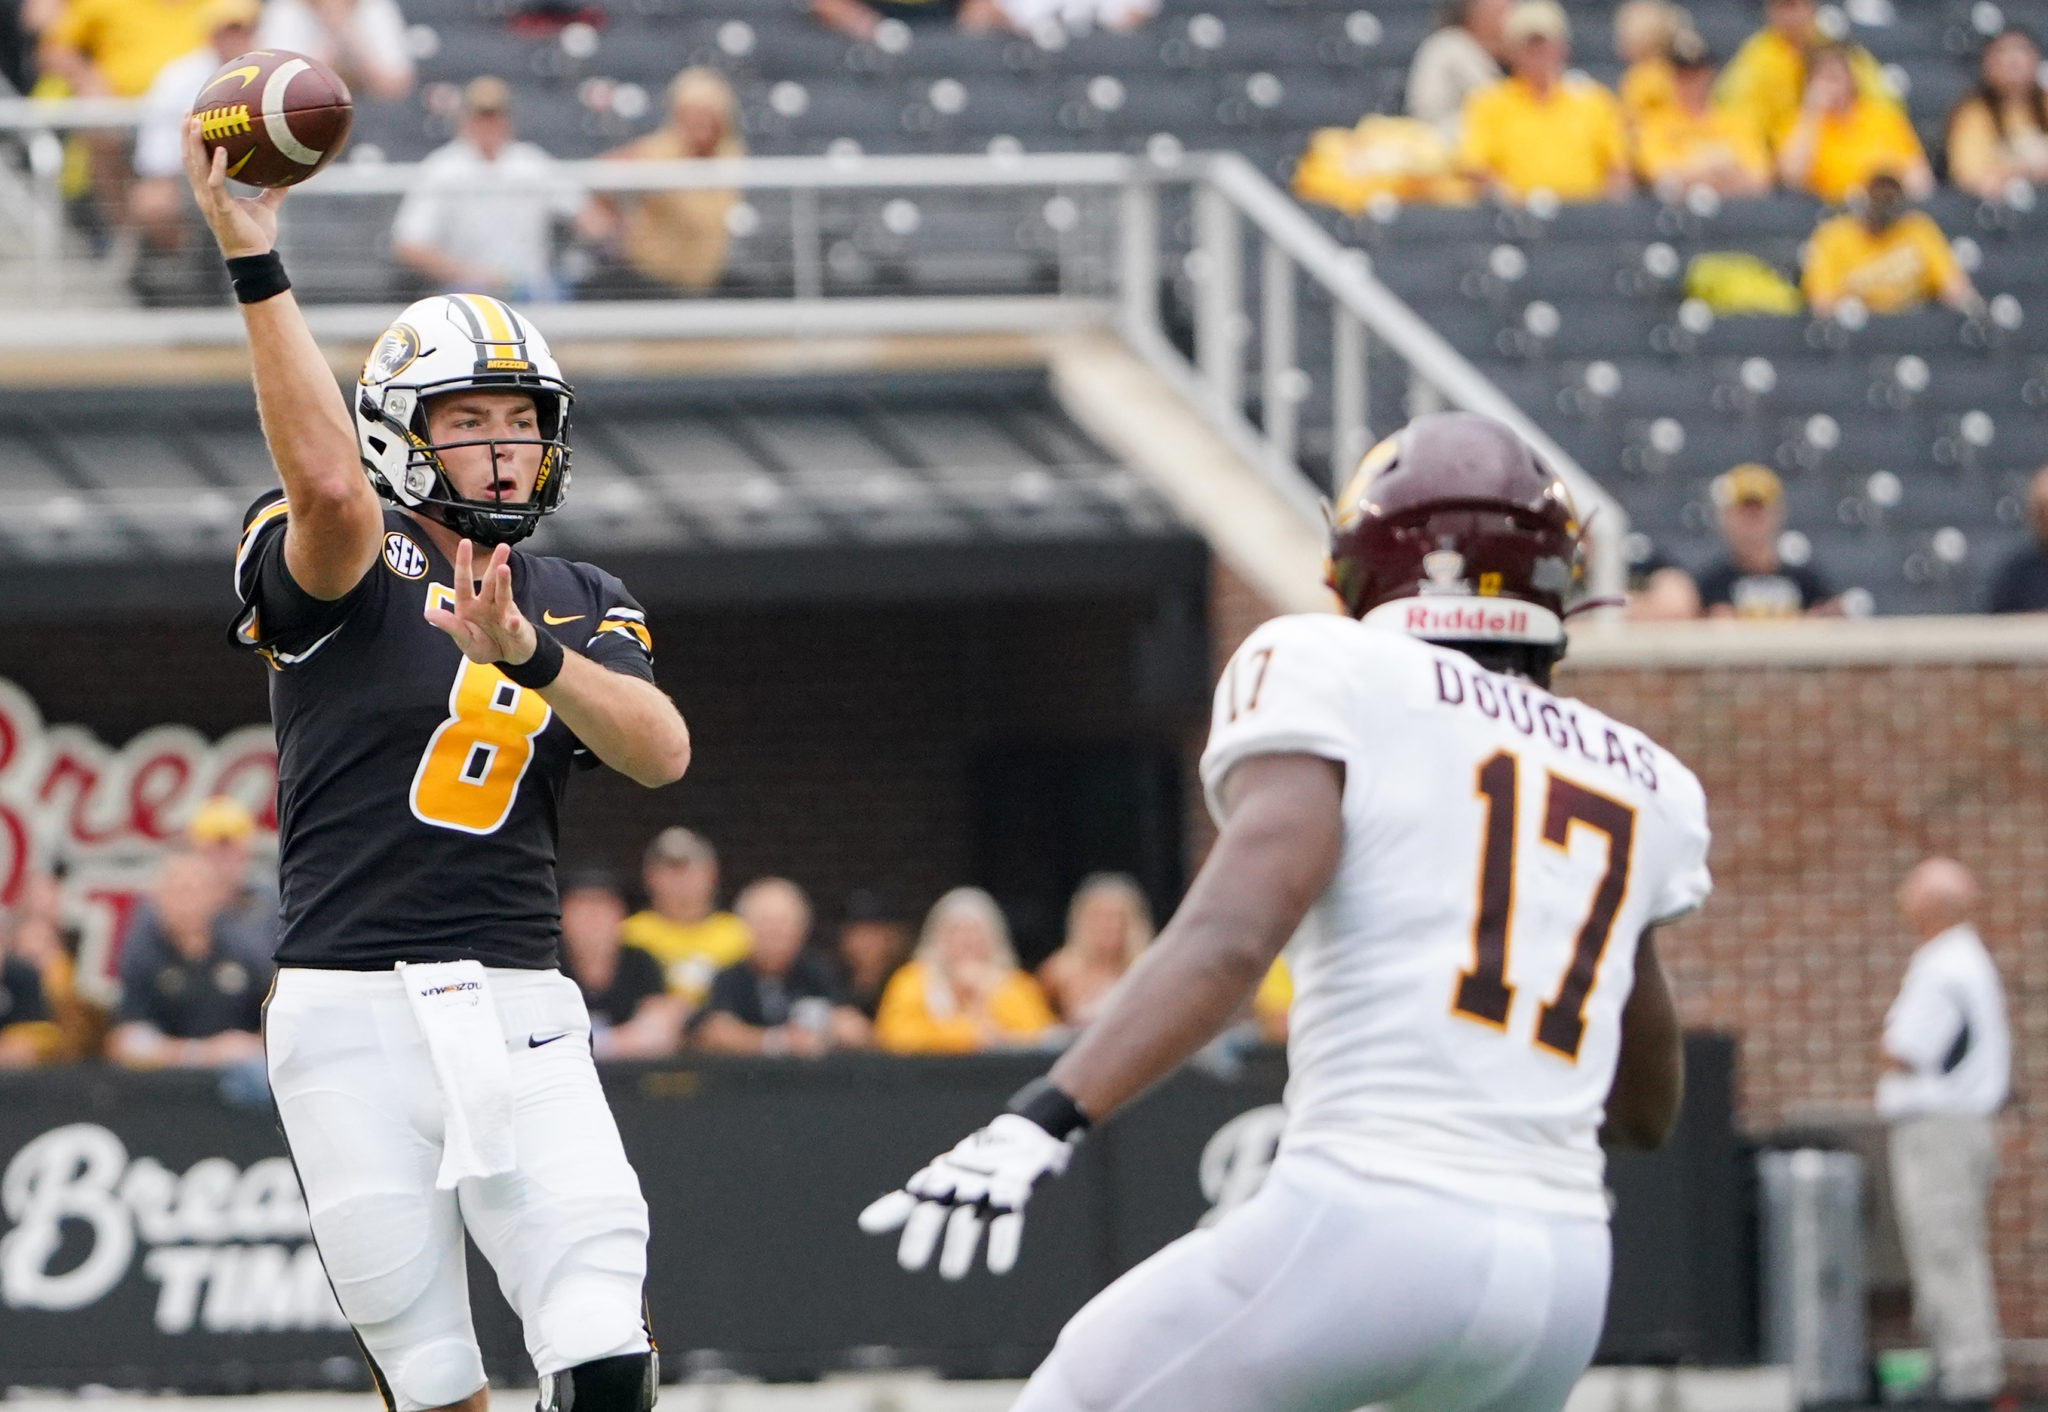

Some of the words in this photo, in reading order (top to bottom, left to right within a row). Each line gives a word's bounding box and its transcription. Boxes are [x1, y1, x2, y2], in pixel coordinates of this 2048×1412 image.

[487, 360, 528, 369] MIZZOU
[386, 535, 425, 576] SEC
[1406, 607, 1528, 632] Riddell
[1227, 646, 1273, 723] 17
[1432, 660, 1658, 792] DOUGLAS
[409, 654, 551, 836] 8
[1449, 748, 1637, 1066] 17
[0, 1123, 309, 1311] Brea
